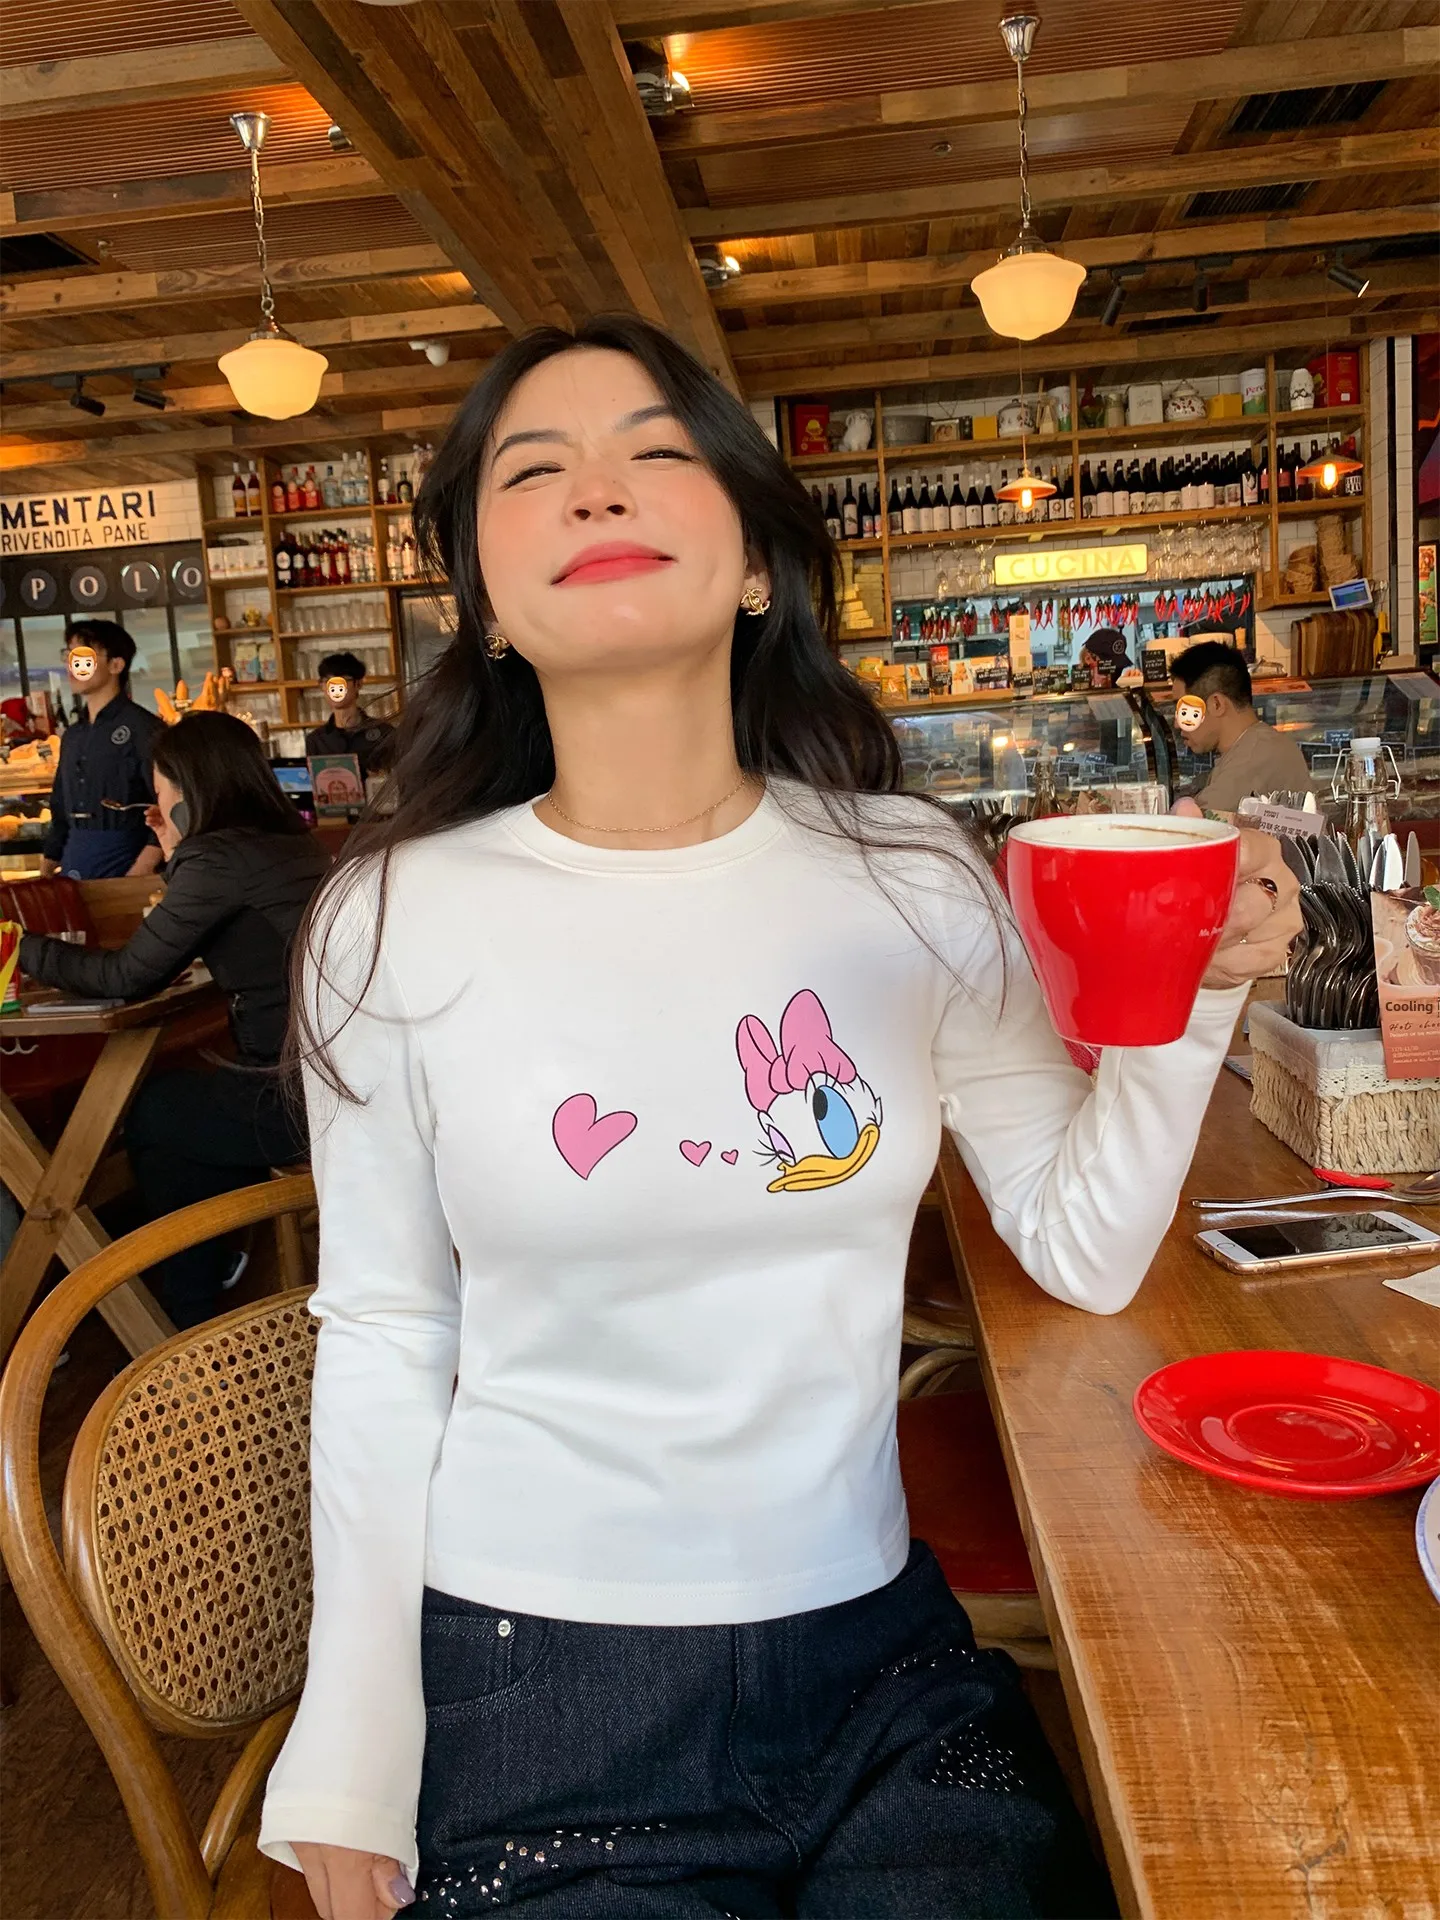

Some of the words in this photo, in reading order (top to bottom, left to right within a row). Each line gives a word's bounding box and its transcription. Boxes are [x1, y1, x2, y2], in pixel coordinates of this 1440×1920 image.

[0, 490, 156, 530] MENTARI
[1, 528, 94, 552] RIVENDITA
[103, 522, 149, 543] PANE
[1009, 550, 1137, 580] CUCINA
[1385, 1000, 1433, 1015] Cooling
[1389, 1022, 1413, 1031] Hot
